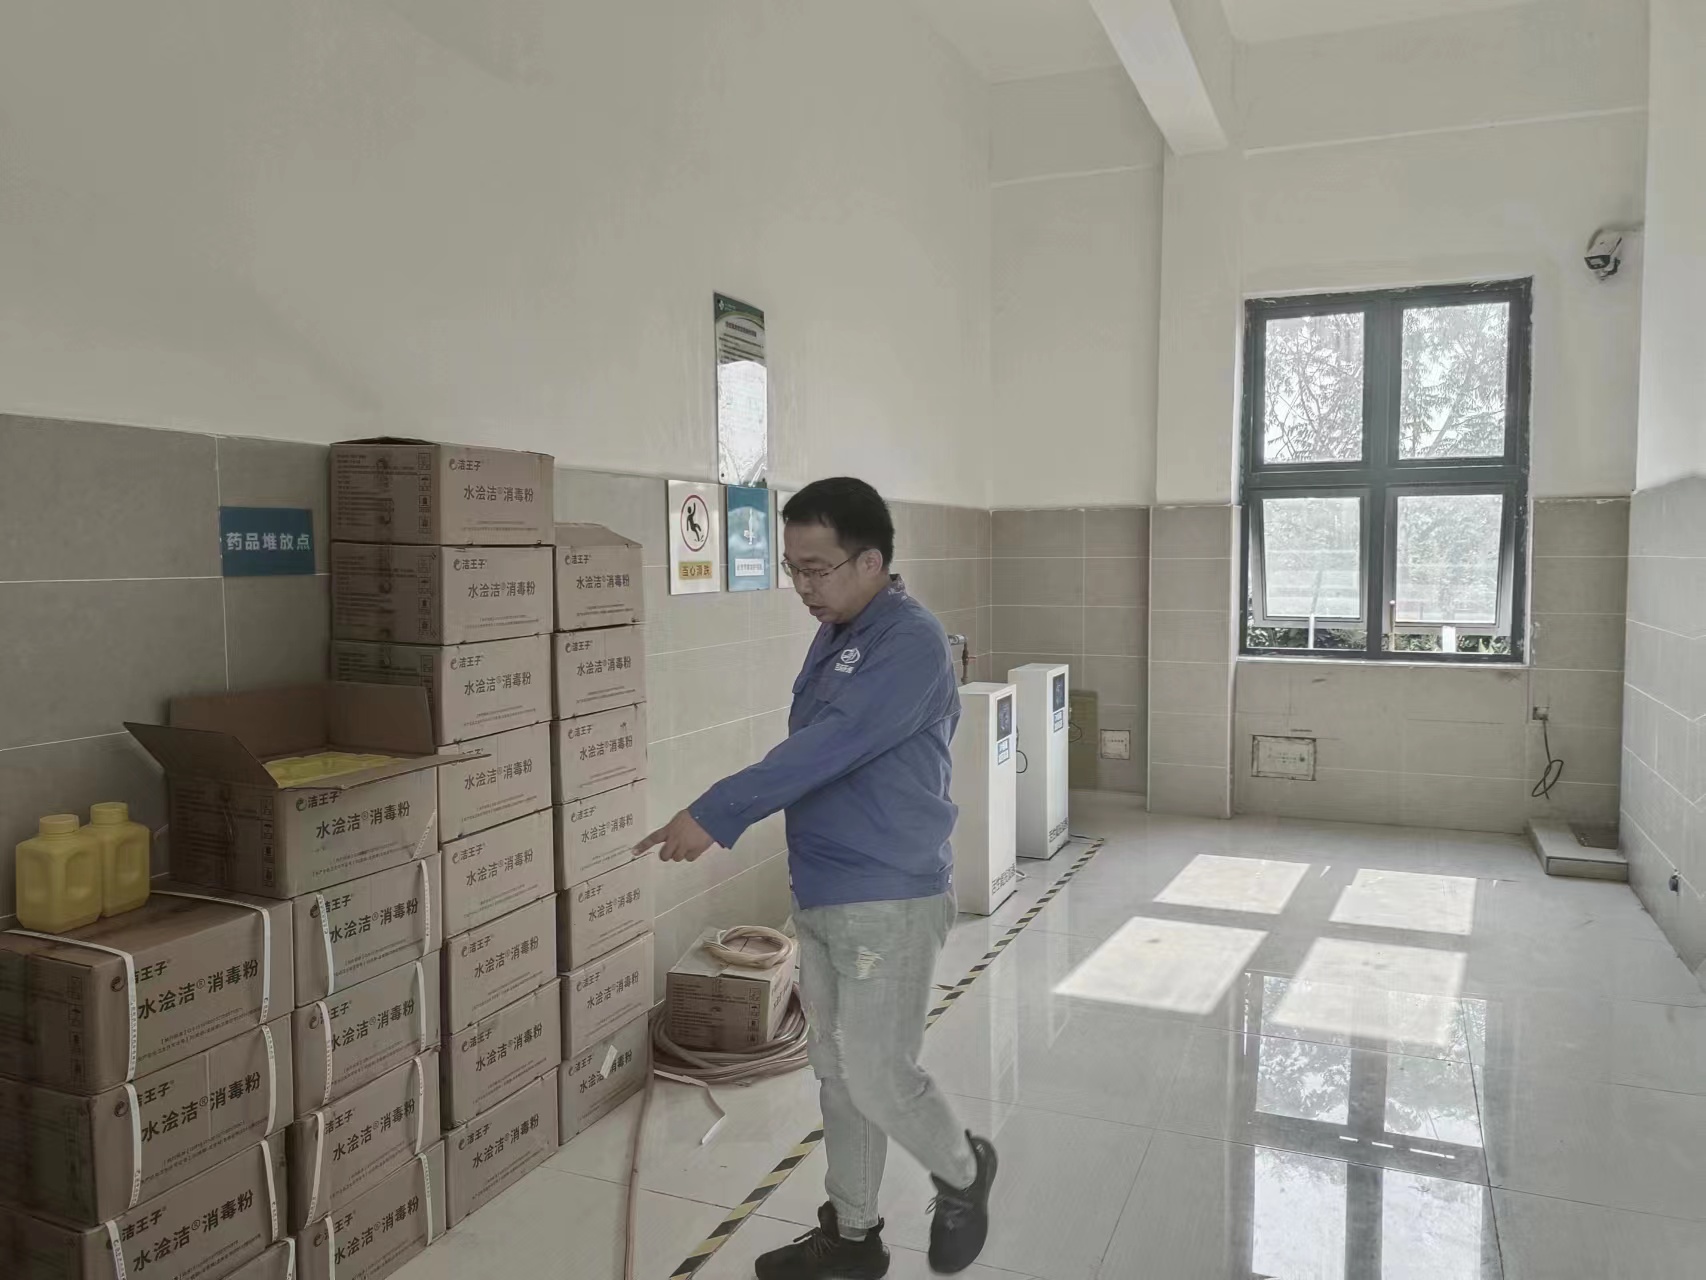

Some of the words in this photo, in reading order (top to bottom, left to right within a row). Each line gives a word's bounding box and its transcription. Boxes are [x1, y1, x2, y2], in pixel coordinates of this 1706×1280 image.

[226, 532, 310, 551] 药品堆放点
